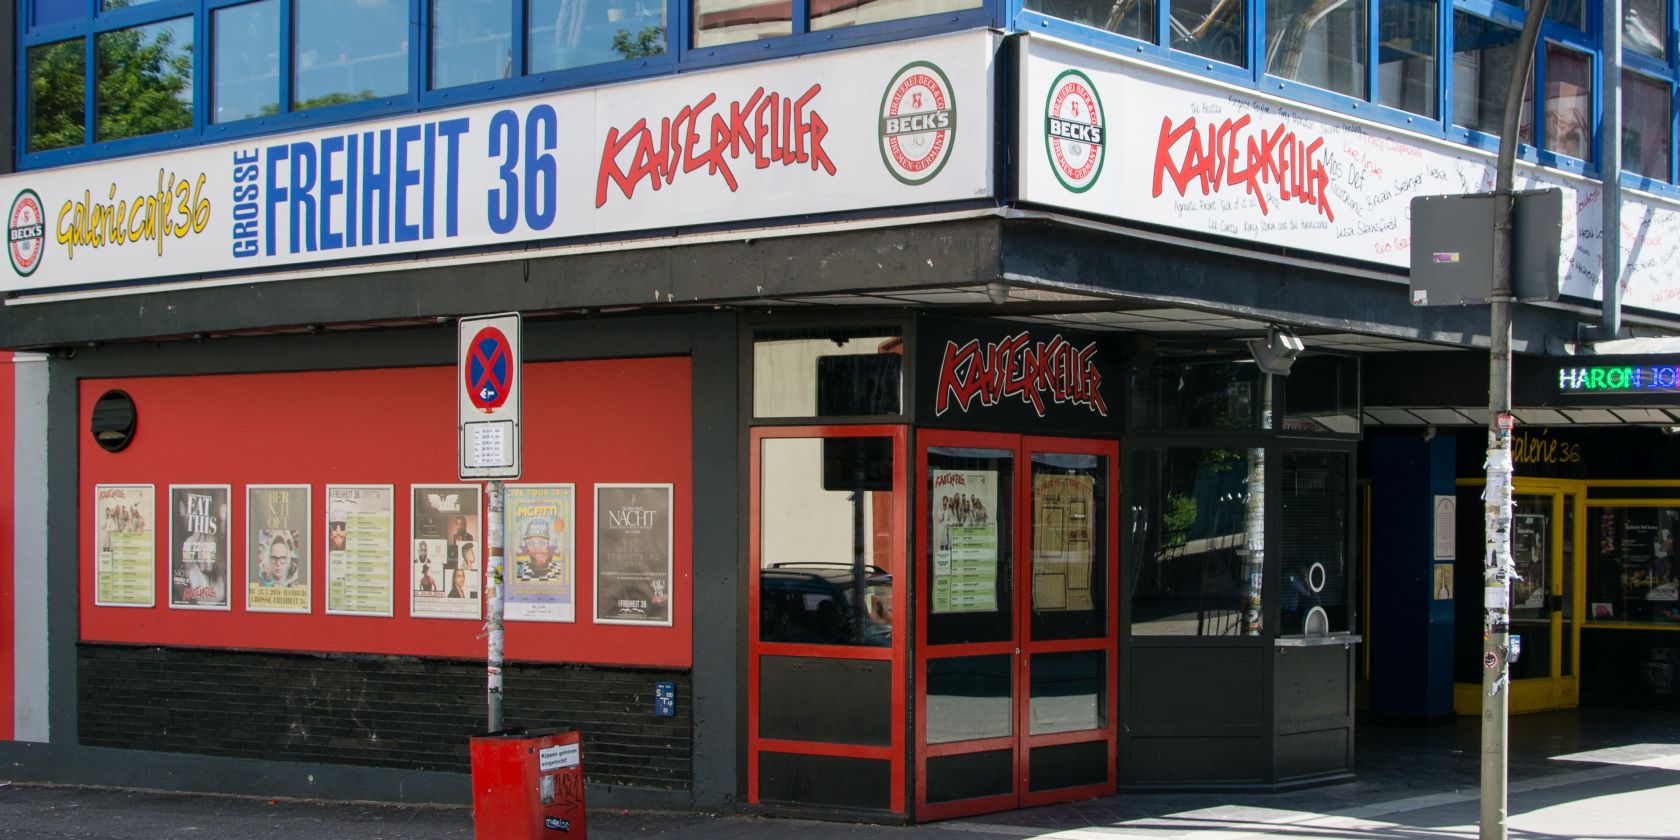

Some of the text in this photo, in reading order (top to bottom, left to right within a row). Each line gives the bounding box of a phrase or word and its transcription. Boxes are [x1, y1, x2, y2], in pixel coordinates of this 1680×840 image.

[886, 112, 949, 135] BECK'S
[1050, 119, 1101, 143] BECK'S
[595, 83, 837, 208] KAISERKELLER
[265, 103, 558, 257] FREIHEIT 36
[1152, 113, 1335, 223] KAISERKELLER
[1323, 147, 1367, 192] Mos Def
[232, 147, 259, 258] GROSSE
[9, 223, 43, 241] BECK'S
[936, 331, 1107, 417] KAISERKELLER
[1511, 427, 1581, 463] alerie 36
[187, 493, 212, 516] EAT
[609, 510, 656, 527] NACHT
[186, 513, 217, 535] THIS
